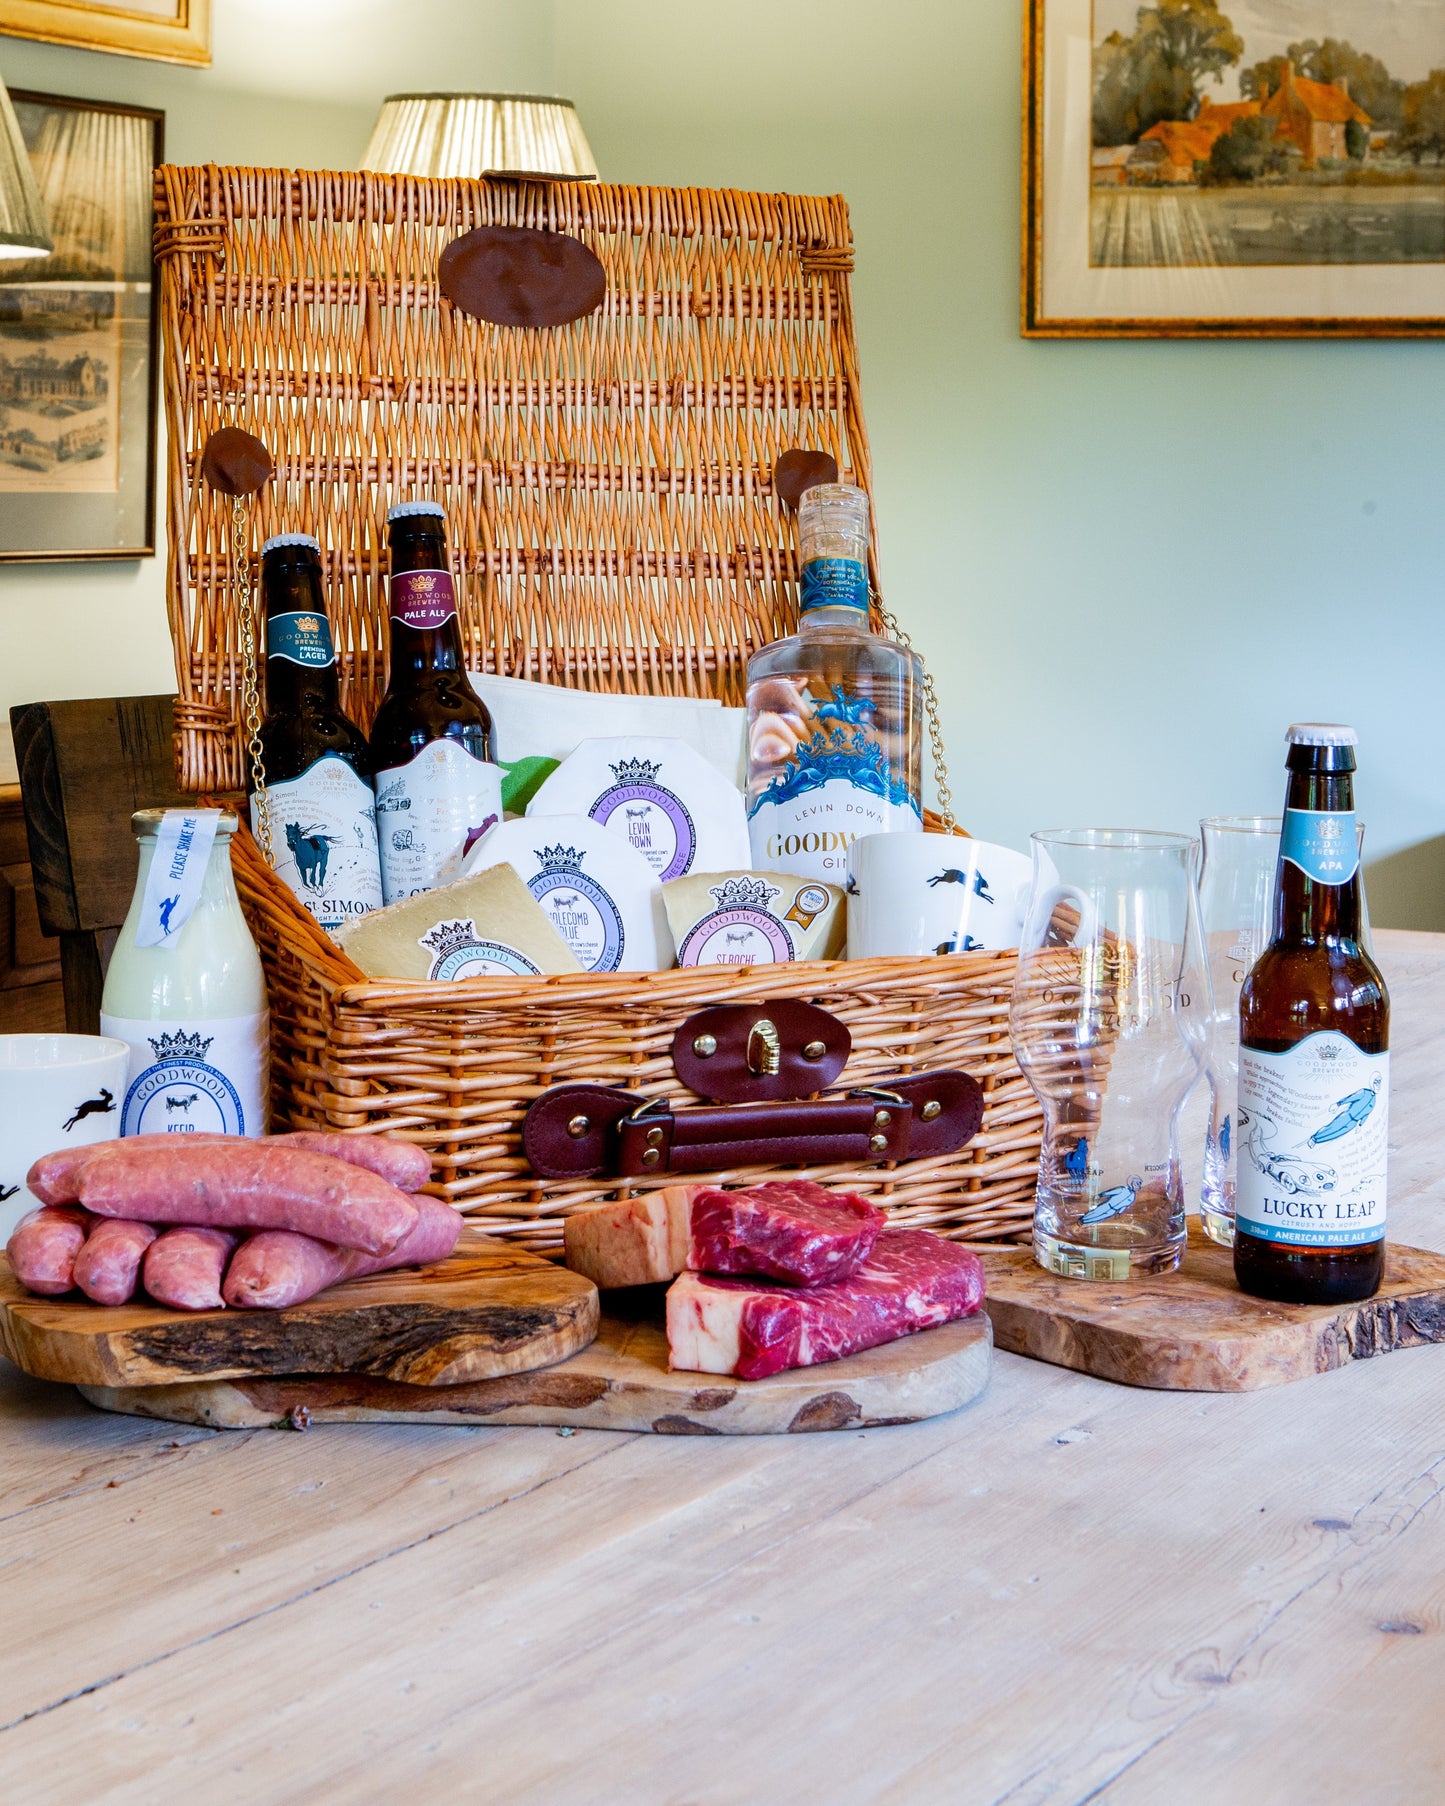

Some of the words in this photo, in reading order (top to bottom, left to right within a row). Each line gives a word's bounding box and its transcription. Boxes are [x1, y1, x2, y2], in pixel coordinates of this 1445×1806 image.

[404, 610, 427, 620] PALE
[429, 609, 445, 617] ALE
[299, 653, 327, 661] LAGER
[795, 804, 833, 822] LEVIN
[846, 804, 885, 824] DOWN
[184, 817, 197, 829] ME
[628, 822, 651, 836] LEVIN
[176, 828, 195, 852] SHAKE
[629, 836, 652, 849] DOWN
[766, 831, 856, 859] GOODW
[169, 850, 189, 880] PLEASE
[1318, 861, 1343, 870] APA
[534, 875, 602, 902] OODWOOD
[322, 900, 376, 914] SIMON
[549, 912, 589, 926] OLECOMB
[700, 912, 779, 938] GOODWOOD
[440, 947, 509, 979] OODWOOD
[595, 945, 616, 973] HEESE
[151, 1063, 162, 1072] THE
[184, 1061, 214, 1073] PRODUCTS
[214, 1071, 225, 1082] AND
[1296, 1060, 1358, 1068] GOODWOOD
[136, 1068, 226, 1101] GOODWOOD
[1263, 1197, 1328, 1219] LUCKY
[1336, 1200, 1376, 1219] LEAP
[1281, 1219, 1316, 1228] CITRUSY
[1319, 1220, 1335, 1229] AND
[1275, 1231, 1325, 1242] AMERICAN
[1328, 1234, 1349, 1242] PALE
[1351, 1232, 1366, 1240] ALE
